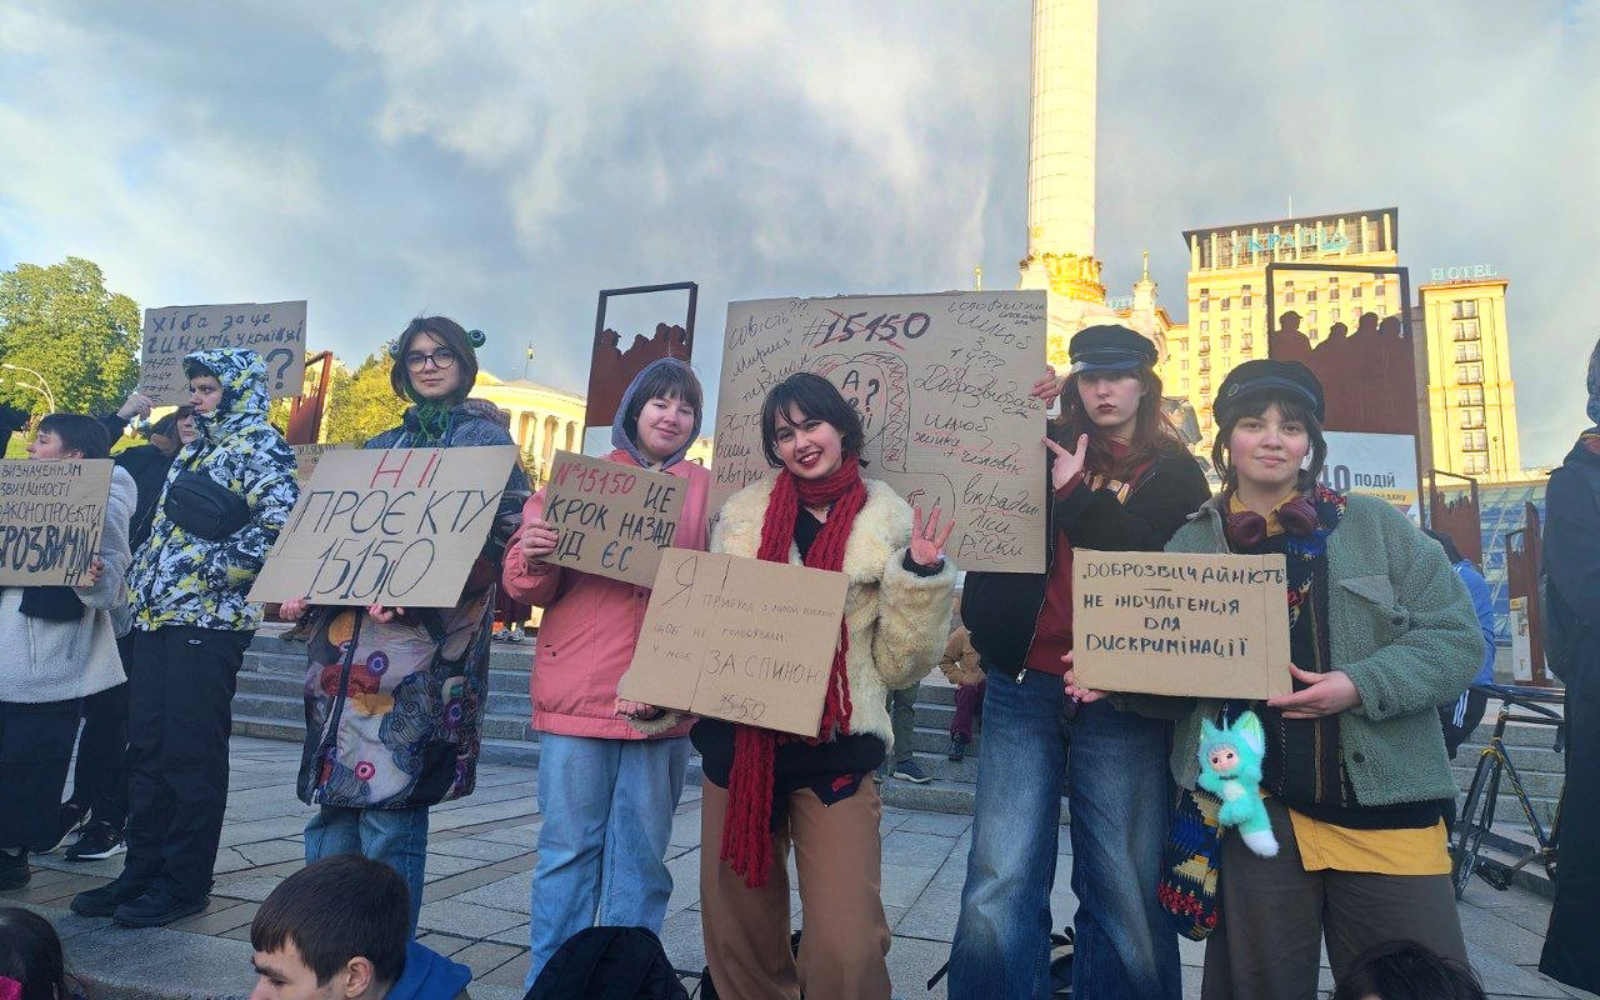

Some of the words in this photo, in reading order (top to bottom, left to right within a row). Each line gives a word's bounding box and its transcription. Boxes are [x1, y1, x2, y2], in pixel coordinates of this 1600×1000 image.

[1430, 264, 1498, 281] HOTEL
[1354, 471, 1396, 488] ПОДІЙ
[643, 481, 676, 514] ЦЕ
[0, 500, 103, 524] АКОНОПРОЄКТИ
[293, 489, 503, 536] ПРОЄКТУ
[545, 494, 609, 531] КРОК
[618, 512, 676, 550] НАЗАД
[302, 538, 436, 600] 15150
[600, 540, 634, 572] ЄС
[1083, 594, 1103, 608] НЕ
[1144, 616, 1181, 630] ДЛЯ
[705, 649, 736, 677] ЗА
